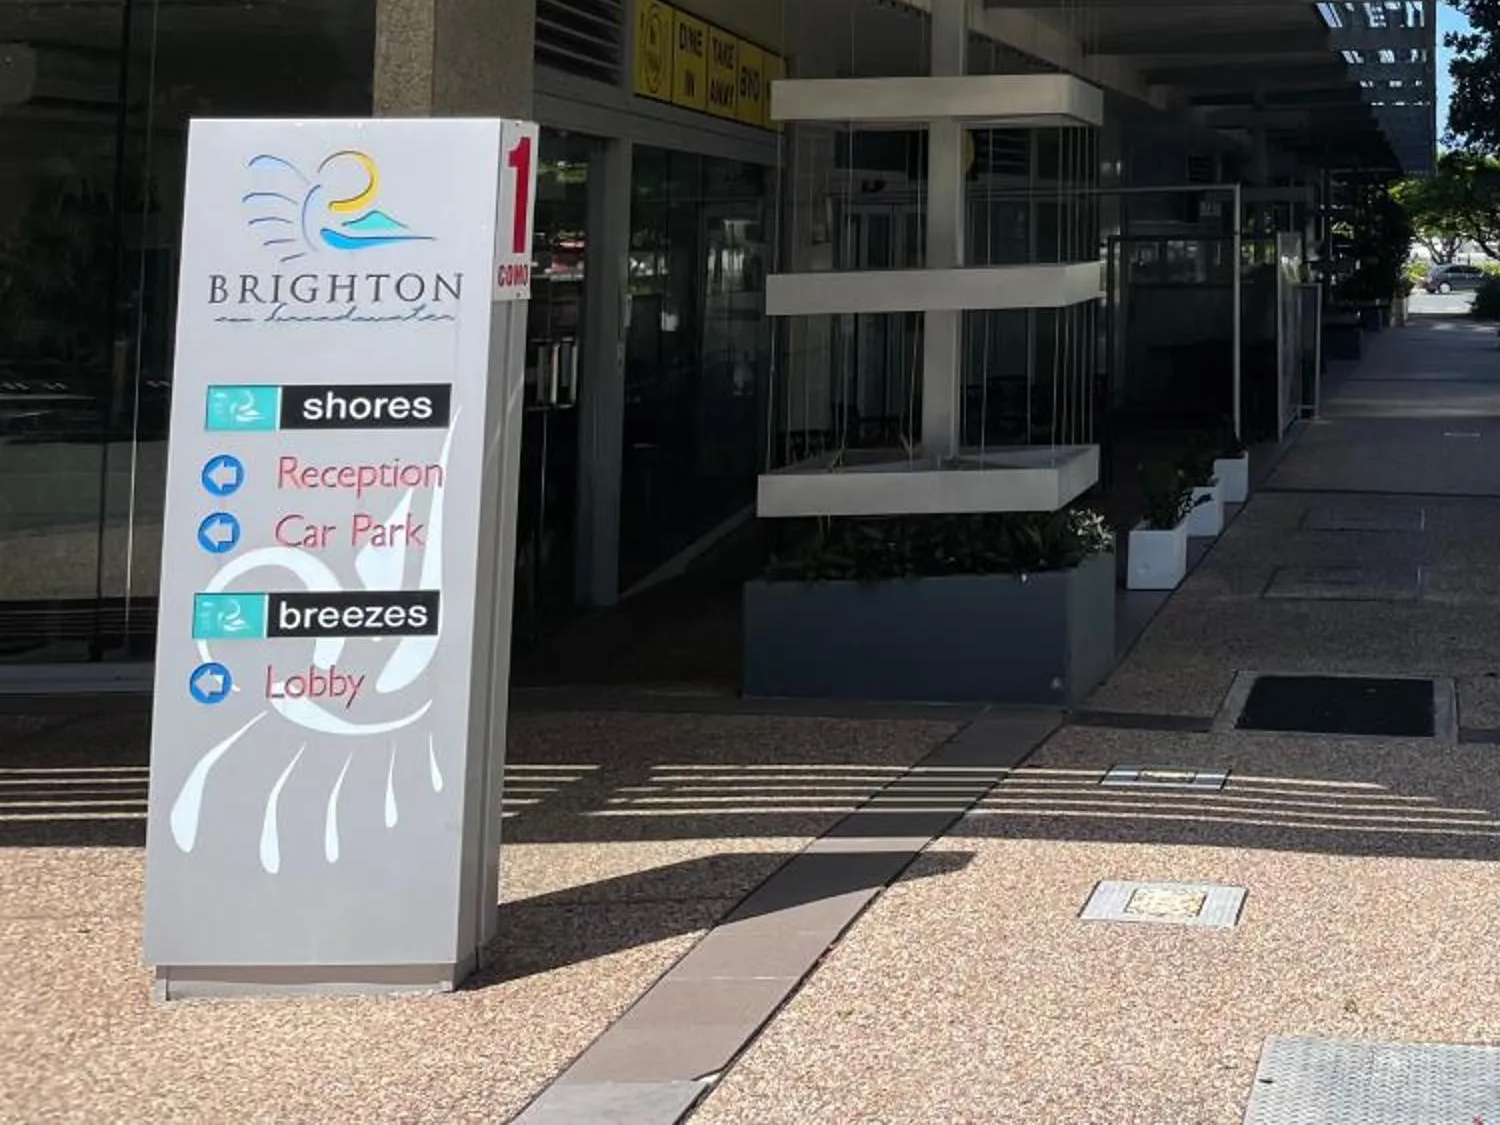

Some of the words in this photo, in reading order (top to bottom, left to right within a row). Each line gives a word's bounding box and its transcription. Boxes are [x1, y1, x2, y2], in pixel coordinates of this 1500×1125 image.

[679, 22, 703, 57] DINE
[712, 36, 735, 70] TAKE
[710, 77, 735, 108] AWAY
[508, 136, 532, 254] 1
[208, 273, 464, 305] BRIGHTON
[497, 263, 530, 287] COMO
[302, 390, 433, 421] shores
[277, 455, 443, 498] Reception
[275, 514, 336, 549] Car
[352, 513, 425, 548] Park
[279, 600, 428, 630] breezes
[266, 666, 366, 709] Lobby
